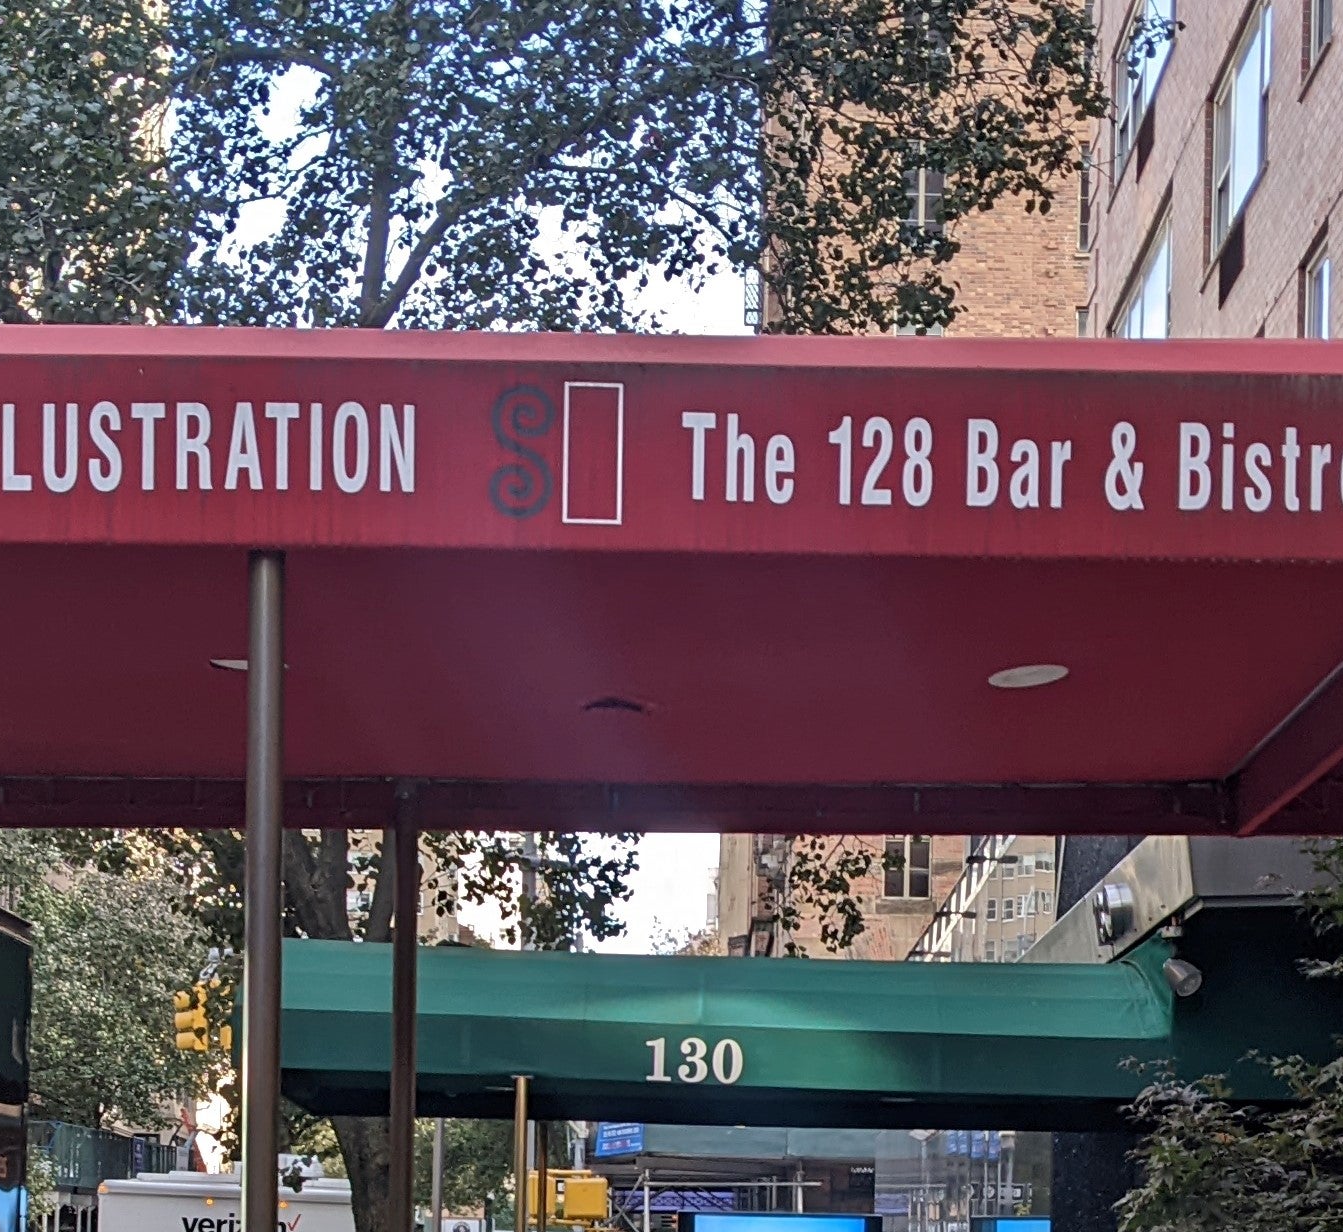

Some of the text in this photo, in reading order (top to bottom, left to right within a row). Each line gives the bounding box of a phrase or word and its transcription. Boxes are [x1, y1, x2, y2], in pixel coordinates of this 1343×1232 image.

[682, 411, 796, 504] The
[828, 415, 934, 507] 128
[966, 418, 1073, 510] Bar
[1103, 421, 1145, 511] &
[645, 1037, 744, 1084] 130
